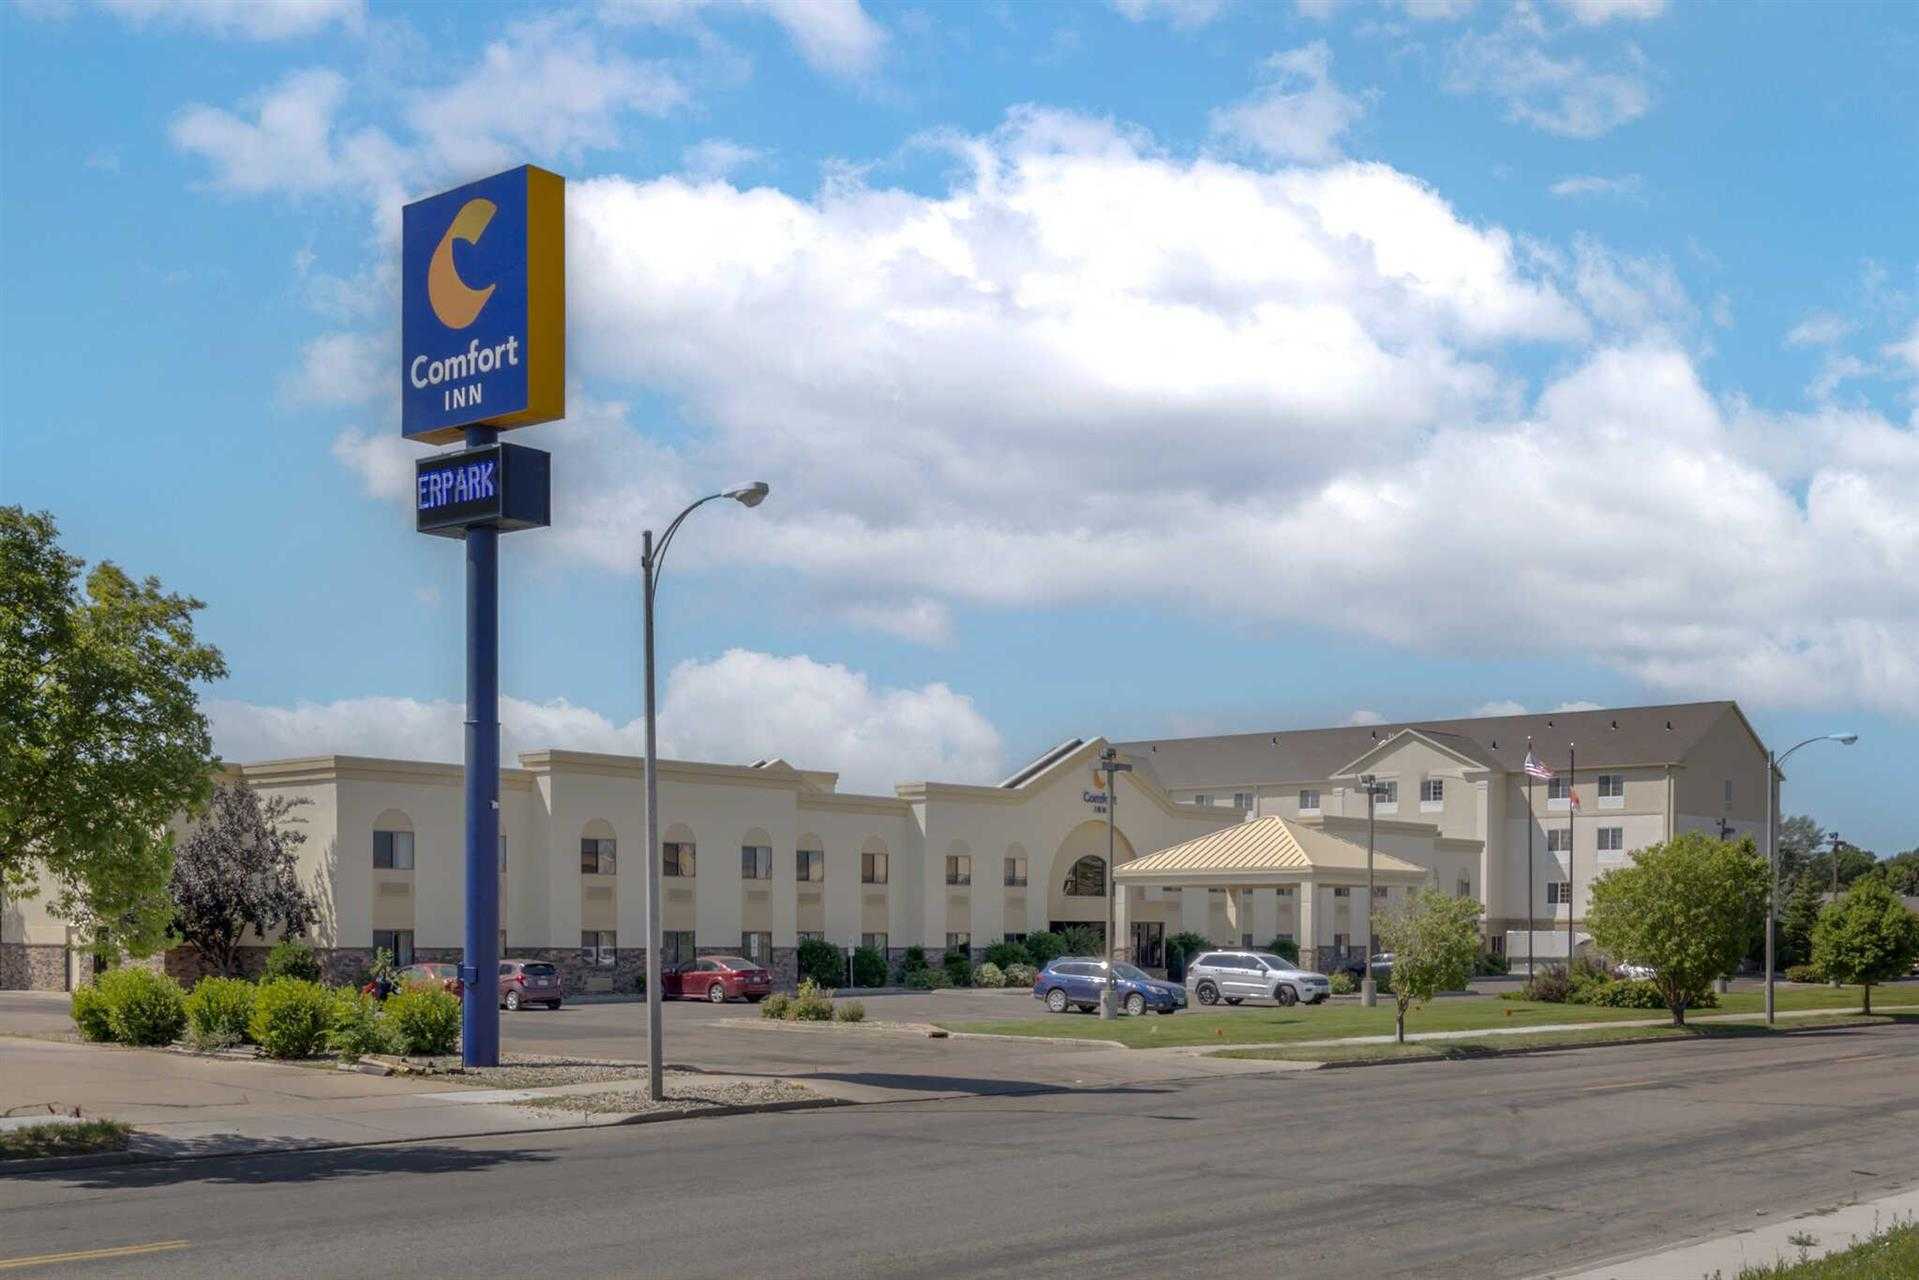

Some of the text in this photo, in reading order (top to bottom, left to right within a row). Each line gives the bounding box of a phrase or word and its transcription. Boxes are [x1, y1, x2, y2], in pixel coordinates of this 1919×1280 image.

[410, 335, 519, 389] Comfort
[444, 382, 482, 411] INN
[418, 461, 495, 510] ERPARK
[1083, 791, 1119, 806] Comft
